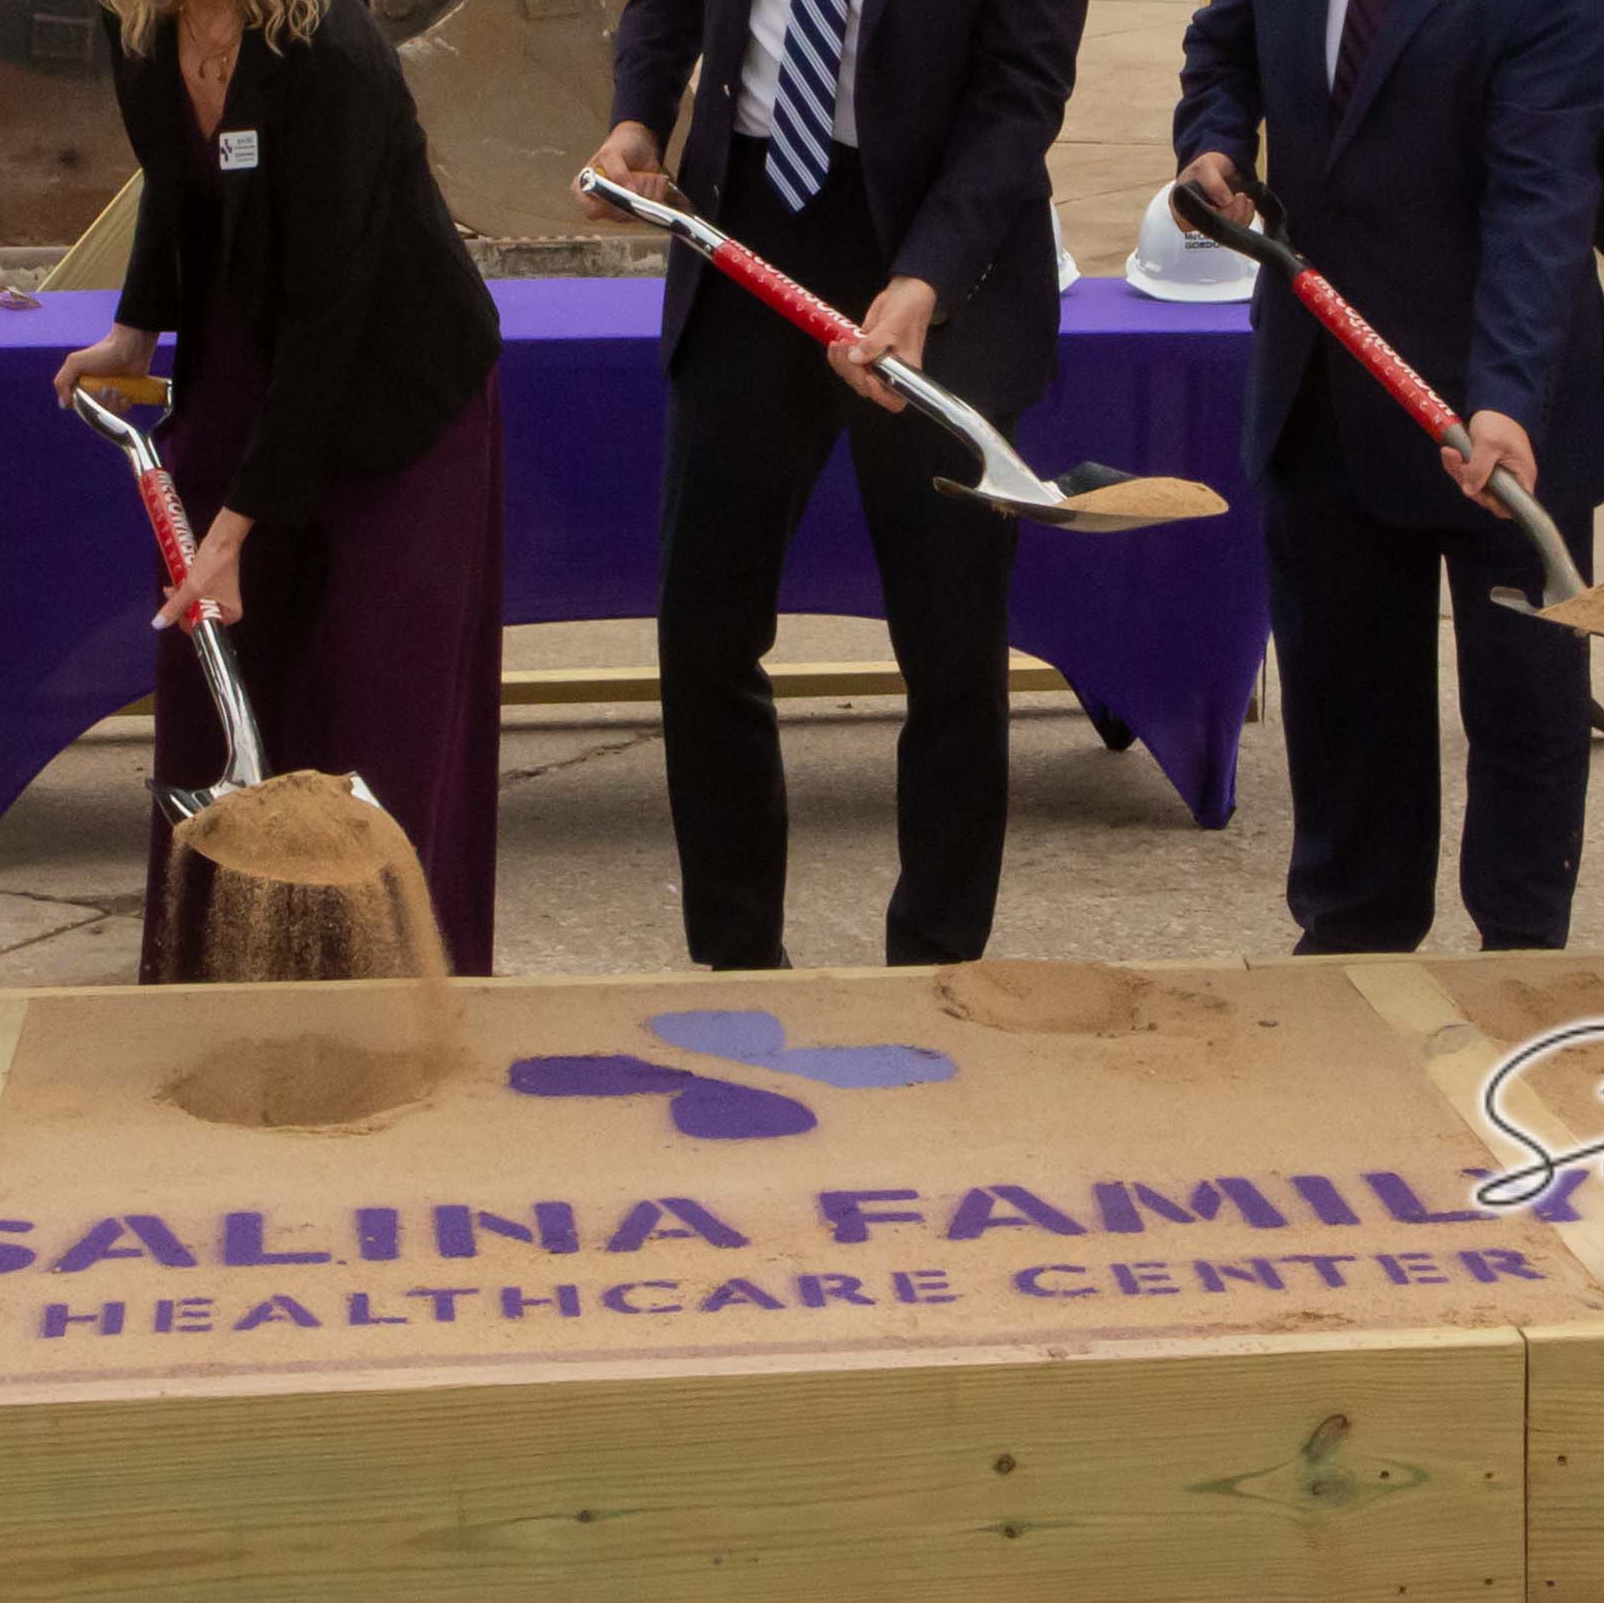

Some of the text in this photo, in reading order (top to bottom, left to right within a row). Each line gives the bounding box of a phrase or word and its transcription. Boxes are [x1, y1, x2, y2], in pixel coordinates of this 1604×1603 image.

[818, 1168, 1591, 1244] FAMILY
[41, 1247, 1547, 1339] HEALTHCARE CENTER
